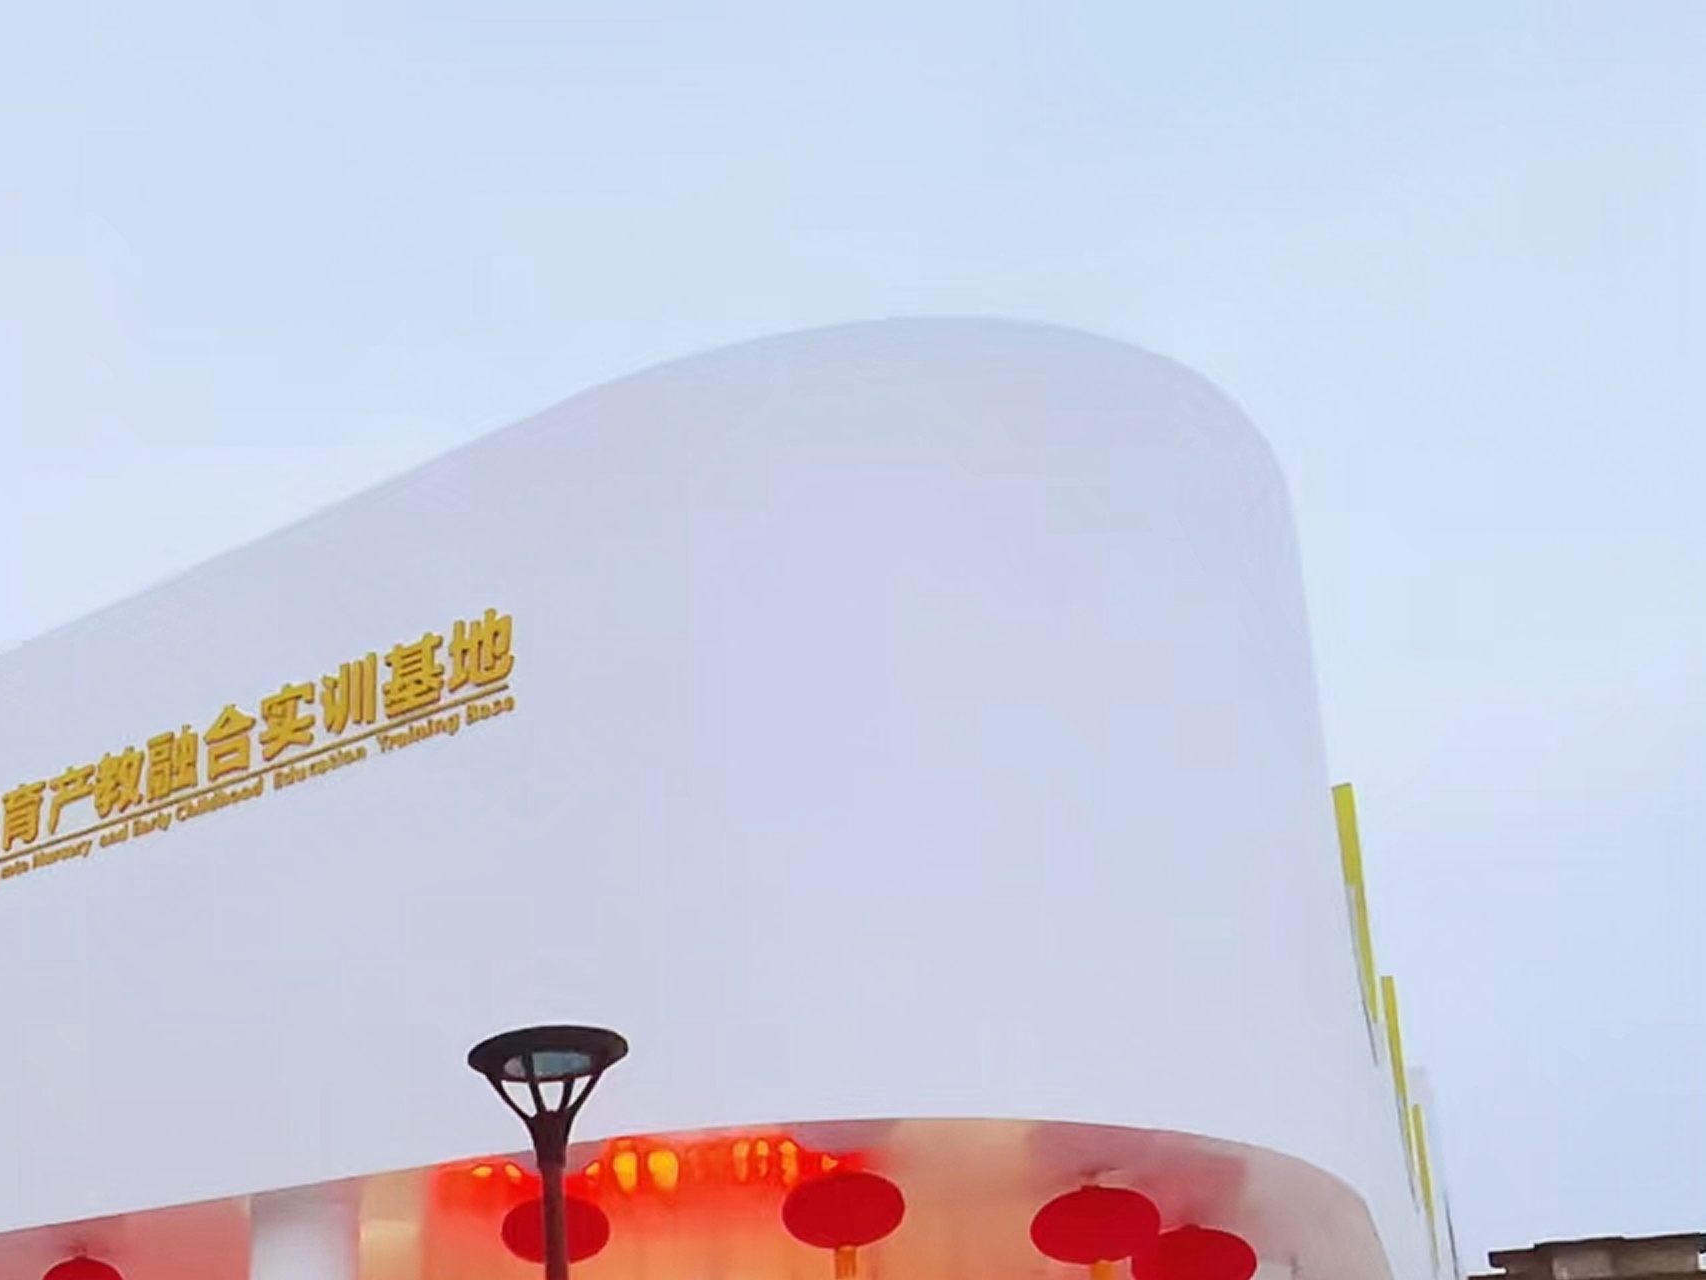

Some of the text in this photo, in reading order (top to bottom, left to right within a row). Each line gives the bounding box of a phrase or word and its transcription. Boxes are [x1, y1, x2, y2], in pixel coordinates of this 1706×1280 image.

[175, 776, 264, 822] Childhood
[273, 745, 367, 789] Education
[375, 712, 460, 752] Training
